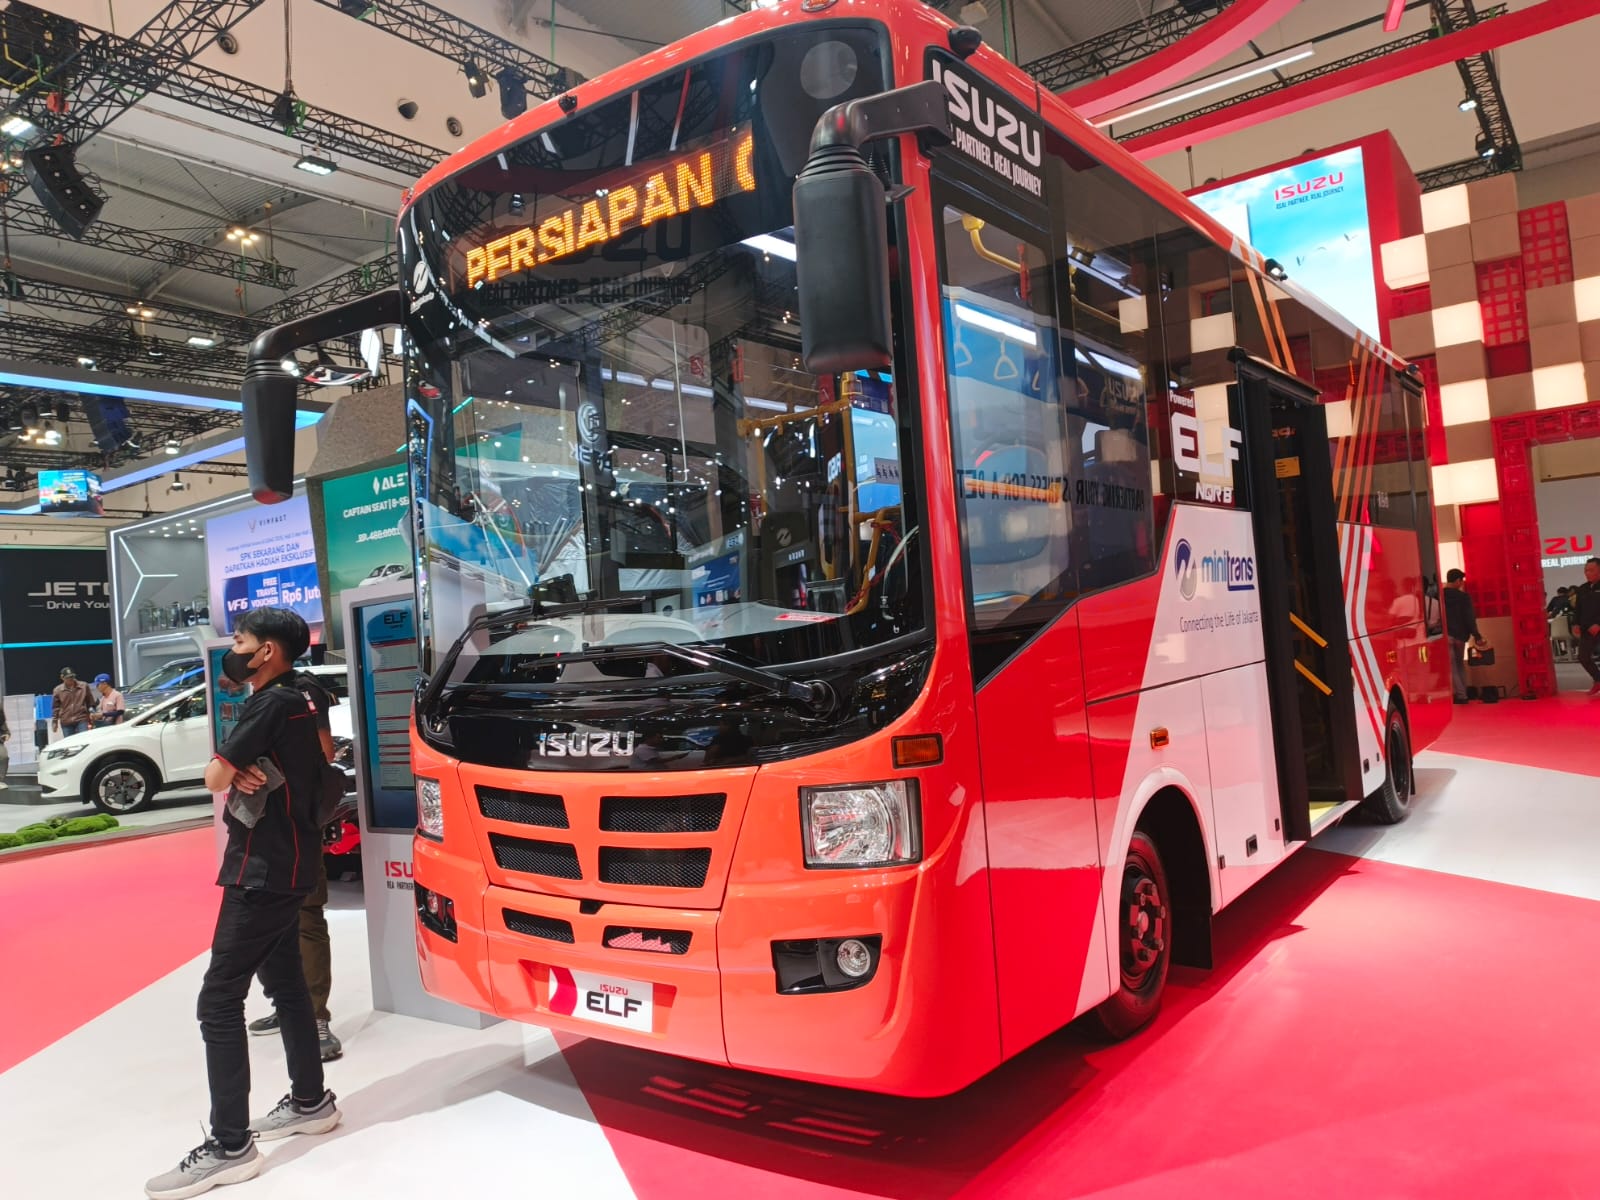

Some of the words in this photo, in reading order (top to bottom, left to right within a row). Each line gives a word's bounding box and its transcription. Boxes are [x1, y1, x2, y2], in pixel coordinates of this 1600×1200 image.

[993, 151, 1012, 180] REAL
[1012, 162, 1042, 197] JOURNEY
[1275, 171, 1343, 201] ISUZU
[466, 152, 714, 288] PERSIAPAN
[1171, 411, 1242, 480] ELF
[1201, 549, 1254, 590] minitrans
[46, 600, 81, 610] Drive
[1180, 614, 1214, 633] Connecting
[1214, 612, 1224, 628] the
[1225, 611, 1235, 627] Life
[536, 730, 635, 757] ISUZU
[586, 990, 642, 1018] ELF
[599, 984, 629, 997] ISUZU
